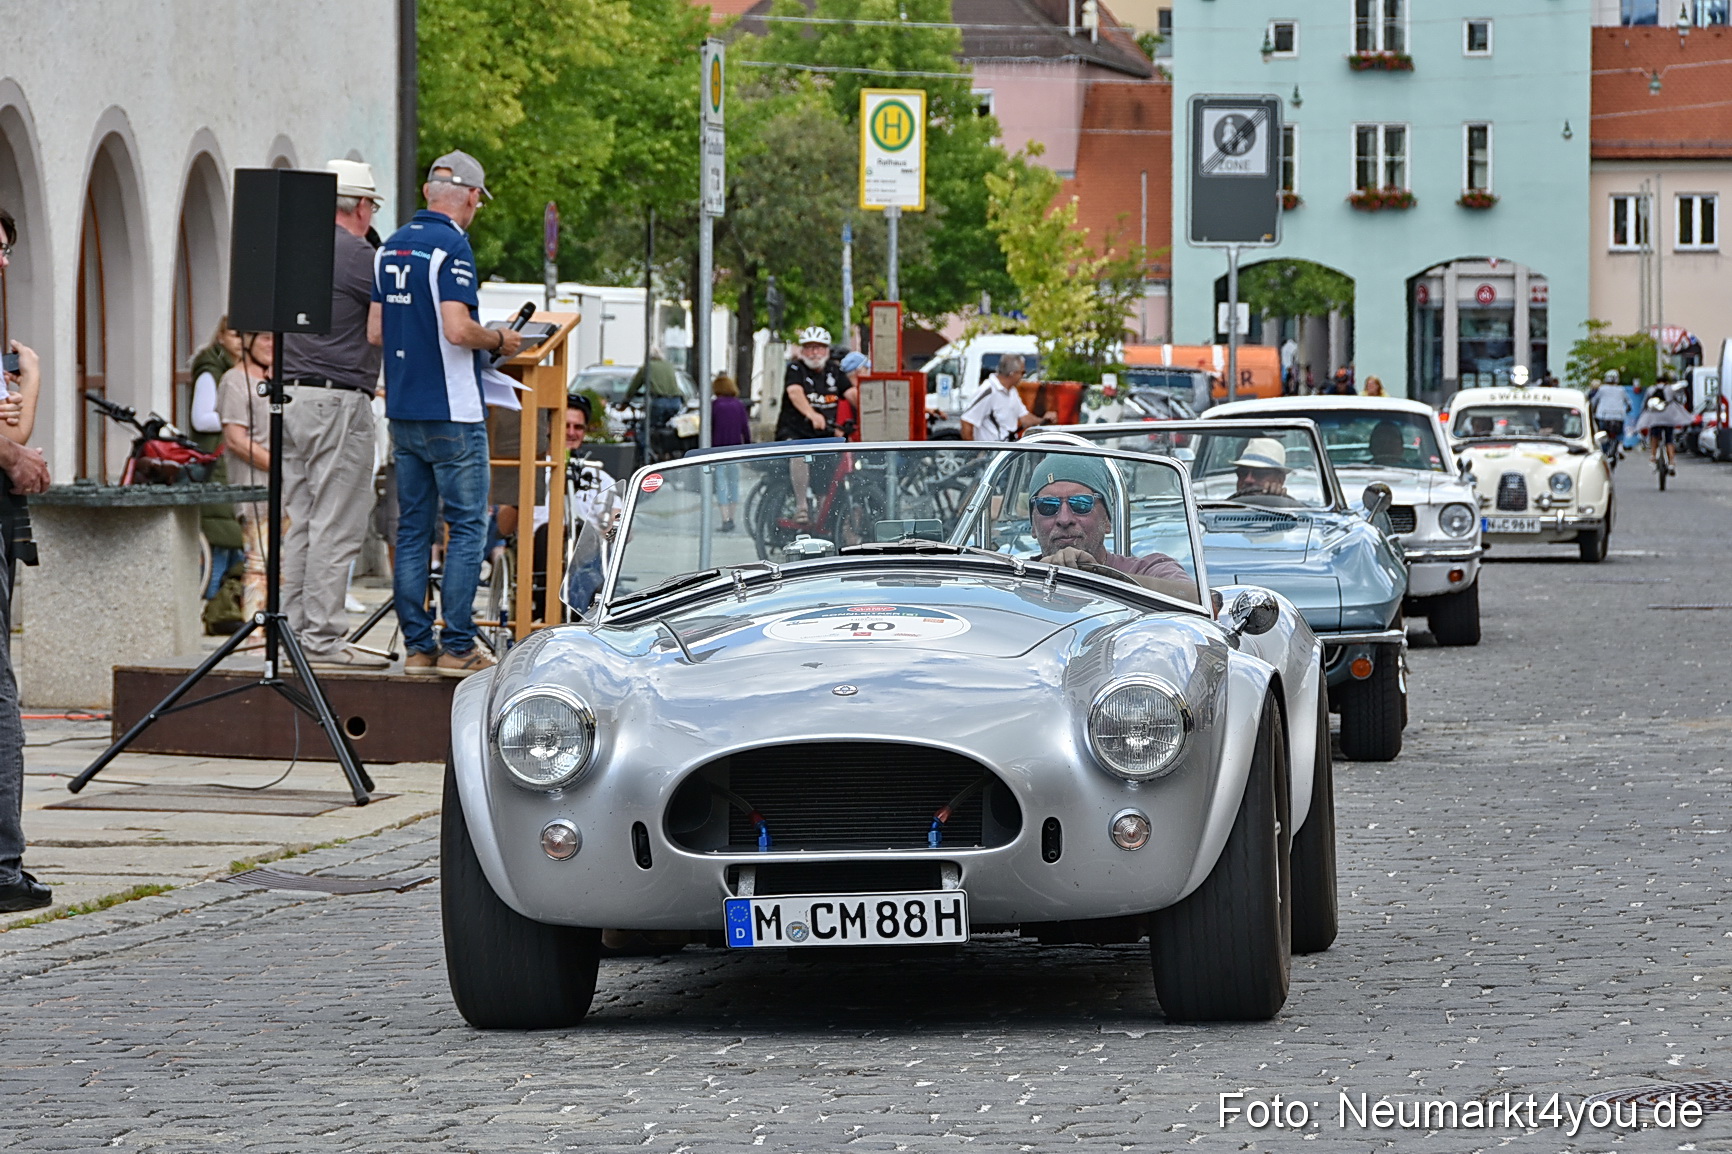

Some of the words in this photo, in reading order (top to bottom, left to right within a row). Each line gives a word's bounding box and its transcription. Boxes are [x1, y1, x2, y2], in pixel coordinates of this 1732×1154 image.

[884, 111, 902, 140] H
[1218, 159, 1251, 171] ZONE
[1490, 392, 1552, 402] SWEDEN
[833, 621, 896, 632] 40
[735, 928, 746, 939] D
